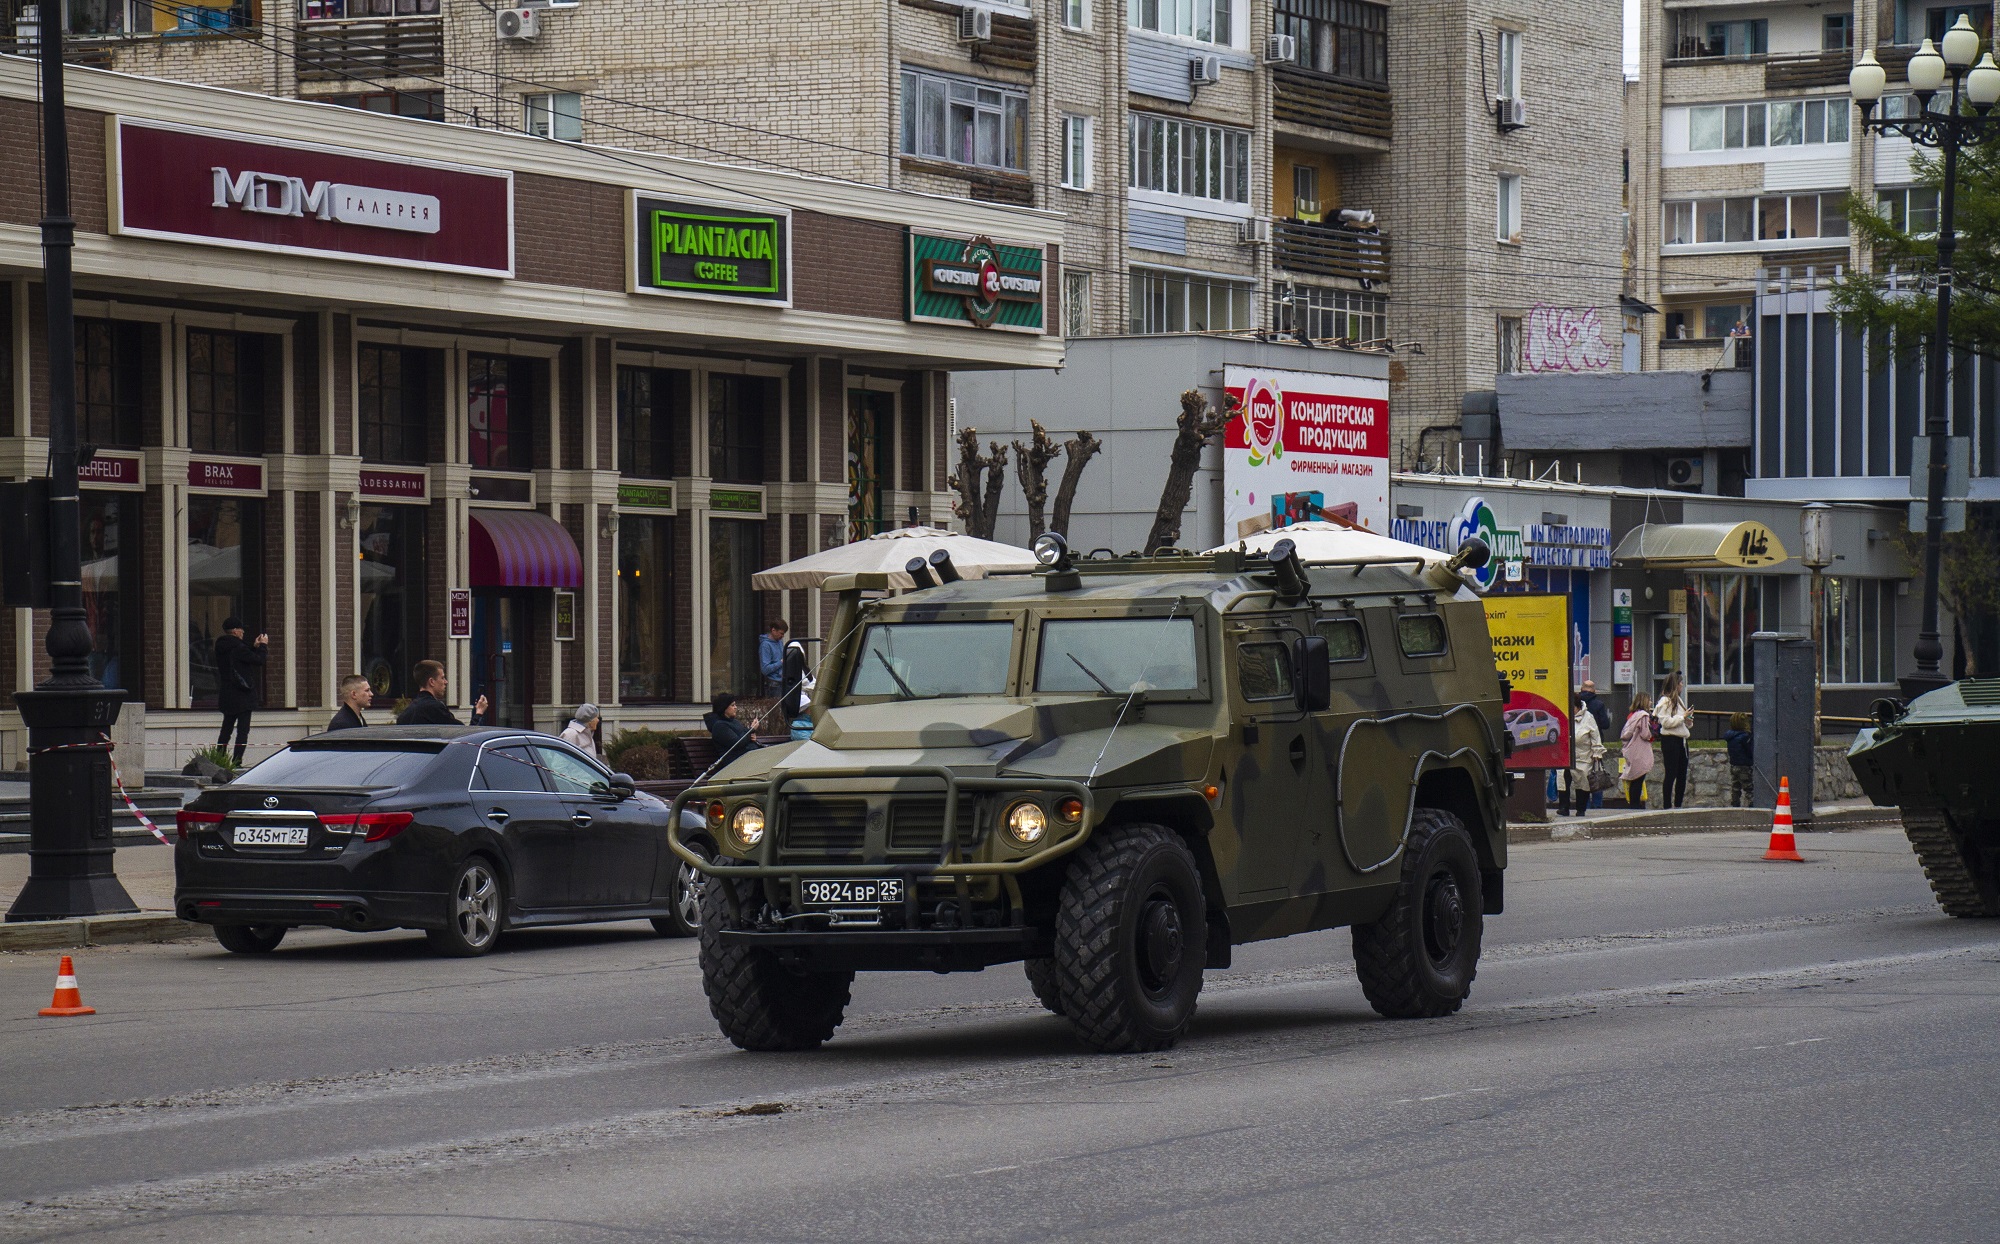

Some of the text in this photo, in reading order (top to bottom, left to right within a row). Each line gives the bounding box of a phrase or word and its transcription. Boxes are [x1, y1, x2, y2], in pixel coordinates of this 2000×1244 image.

[211, 167, 331, 221] MDM
[346, 197, 429, 220] ГАЛЕРЕЯ
[661, 222, 773, 260] PLANTACIA
[694, 261, 739, 282] COFFEE
[934, 268, 1041, 293] GUSTAV & GUSTAV
[1253, 402, 1275, 419] KDV
[1290, 401, 1375, 426] КОНДИТЕРСКАЯ
[1299, 427, 1367, 452] ПРОДУКЦИЯ
[204, 465, 234, 478] BRAX
[1290, 459, 1373, 476] ФИРМЕННЫЙ МАГАЗИН
[1531, 525, 1611, 546] МЫ КОНТРОЛИРУЕМ
[1531, 547, 1612, 568] КАЧЕСТВО И ЦЕНЫ
[1490, 635, 1535, 646] кажи
[290, 829, 304, 840] 27
[880, 881, 898, 896] 25
